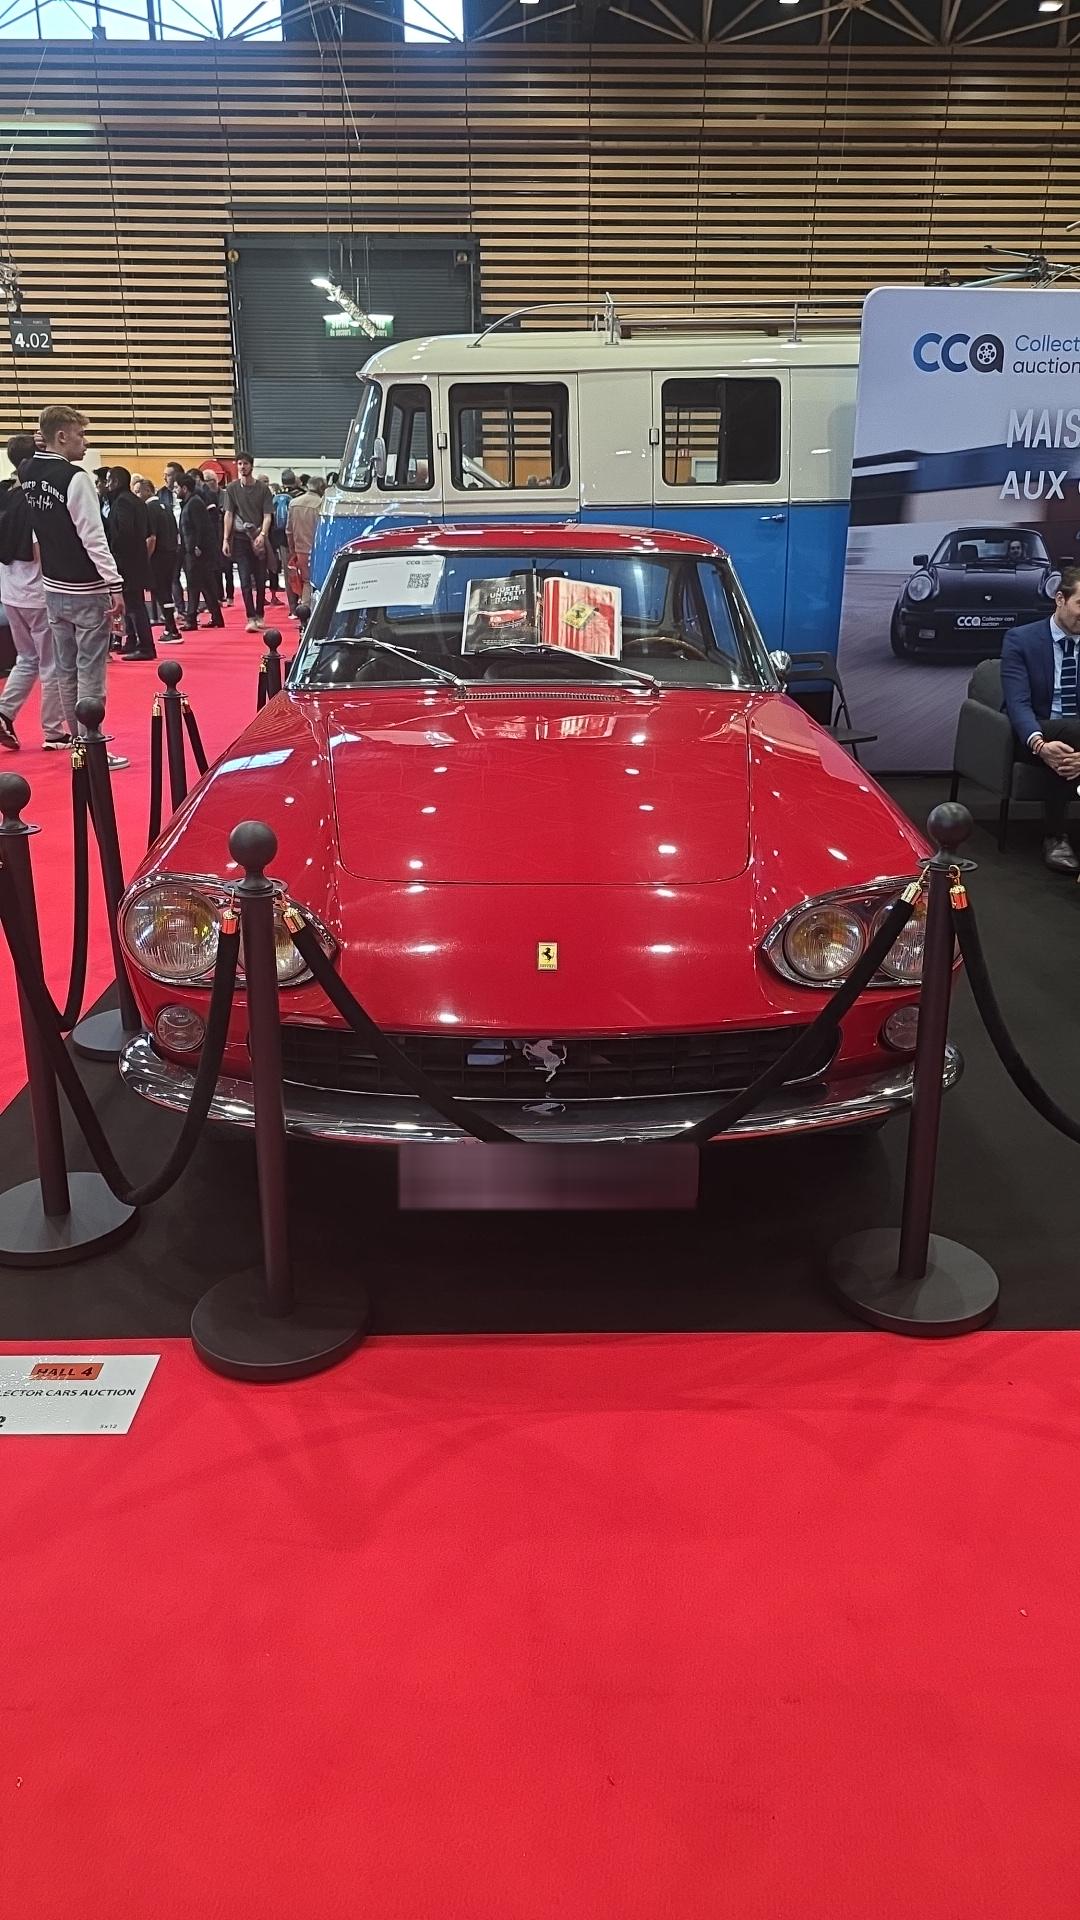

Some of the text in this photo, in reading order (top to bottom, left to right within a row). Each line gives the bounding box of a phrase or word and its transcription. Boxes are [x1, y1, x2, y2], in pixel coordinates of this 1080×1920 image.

[14, 332, 50, 348] 4.02
[1015, 334, 1080, 352] Collect
[1012, 357, 1080, 374] auction
[1006, 408, 1080, 449] MAIS
[999, 470, 1069, 500] AUX
[496, 584, 520, 593] JUSTE
[504, 588, 526, 597] PETIT
[495, 595, 519, 604] TOUR
[36, 1366, 93, 1376] HALL 4
[45, 1389, 77, 1397] CARS
[79, 1389, 137, 1397] AUCTION
